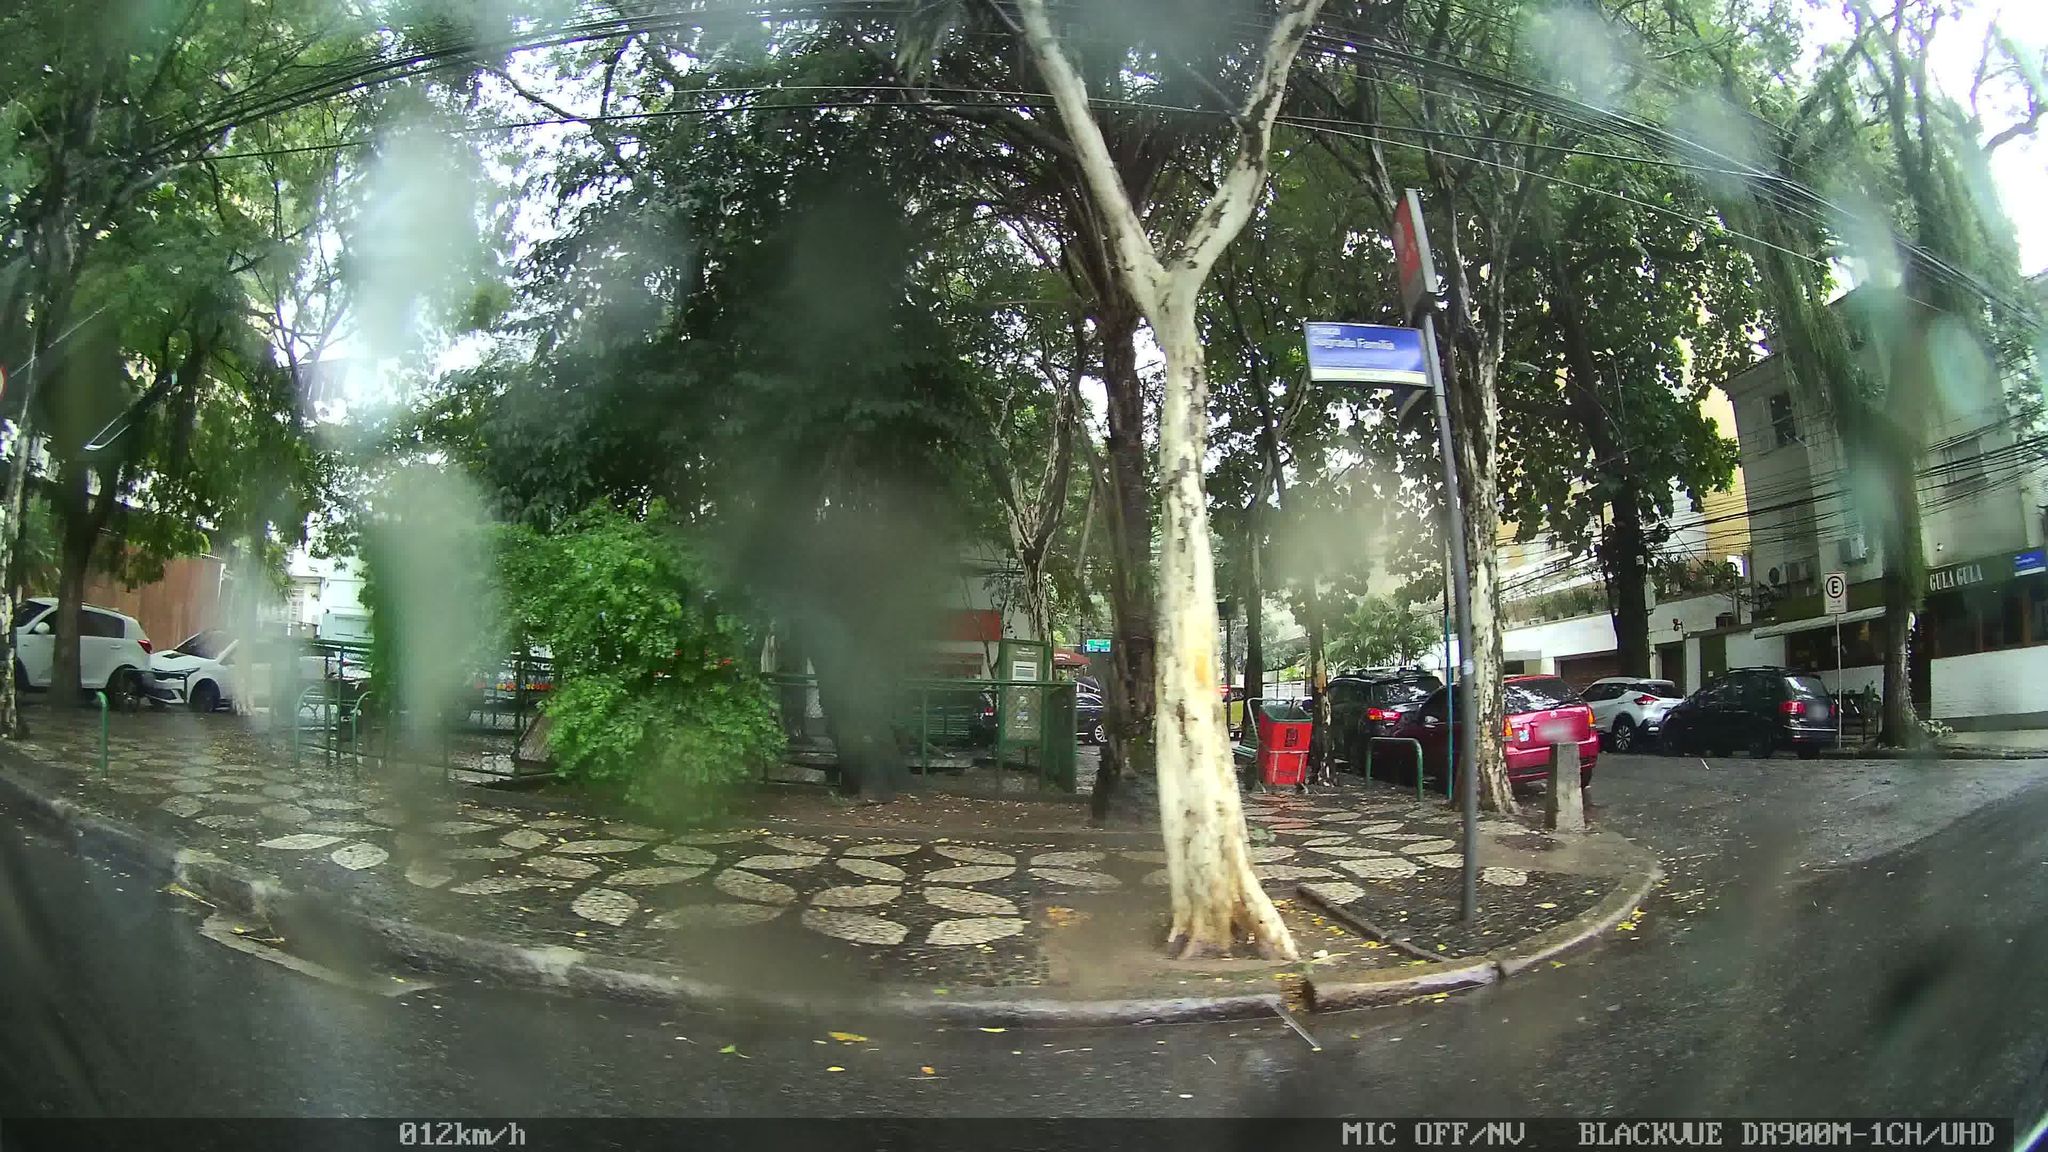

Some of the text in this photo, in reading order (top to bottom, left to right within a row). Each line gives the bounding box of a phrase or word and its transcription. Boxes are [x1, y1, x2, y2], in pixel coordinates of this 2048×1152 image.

[1831, 580, 1839, 594] E
[1929, 564, 1983, 591] GULA GULA
